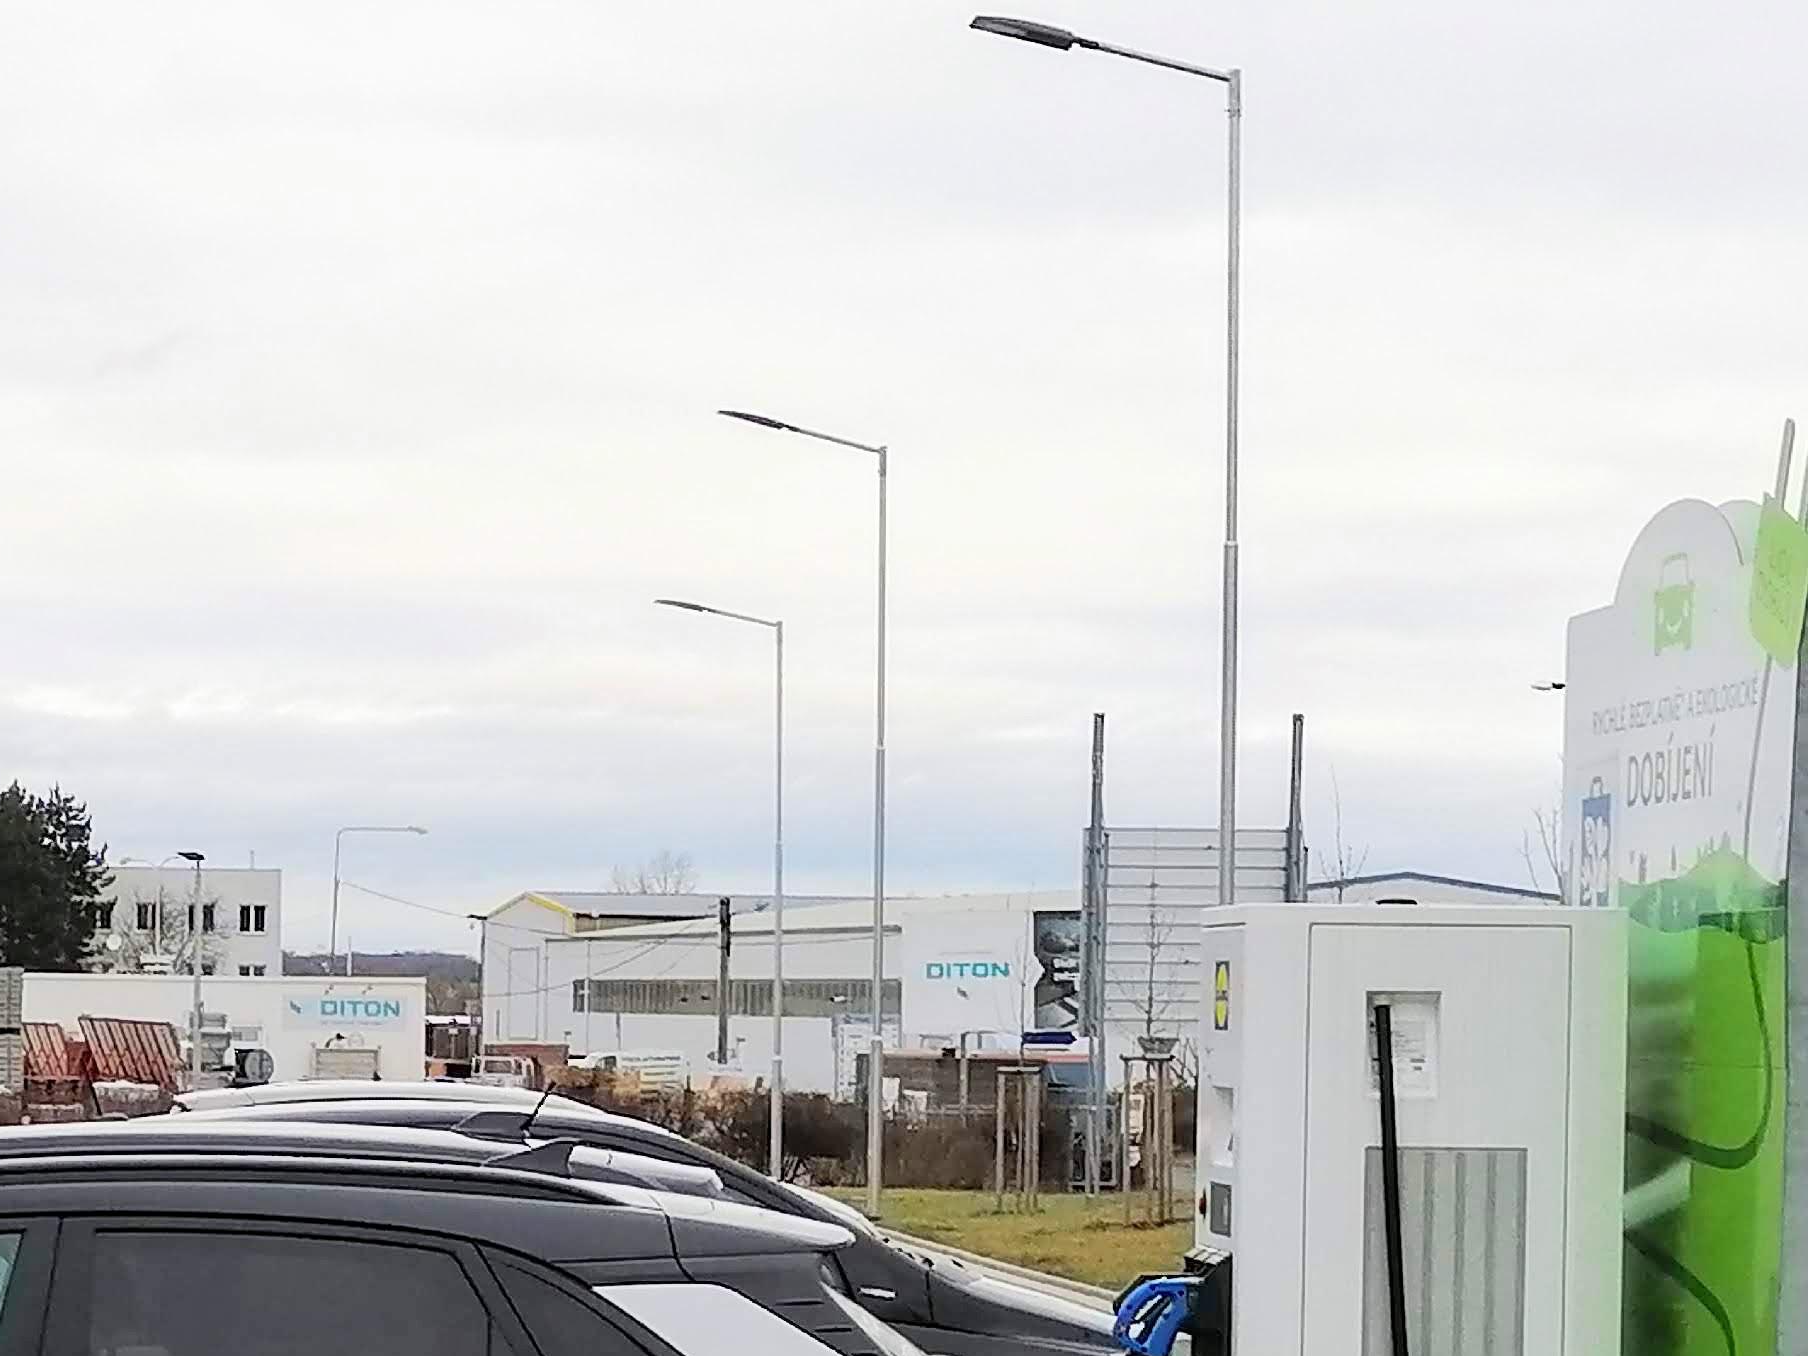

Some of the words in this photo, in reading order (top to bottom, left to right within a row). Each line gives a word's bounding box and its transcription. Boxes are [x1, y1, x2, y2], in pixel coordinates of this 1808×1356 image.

[1627, 722, 1715, 808] DOBÍJENÍ
[926, 962, 1010, 979] DITON
[320, 1000, 400, 1017] DITON
